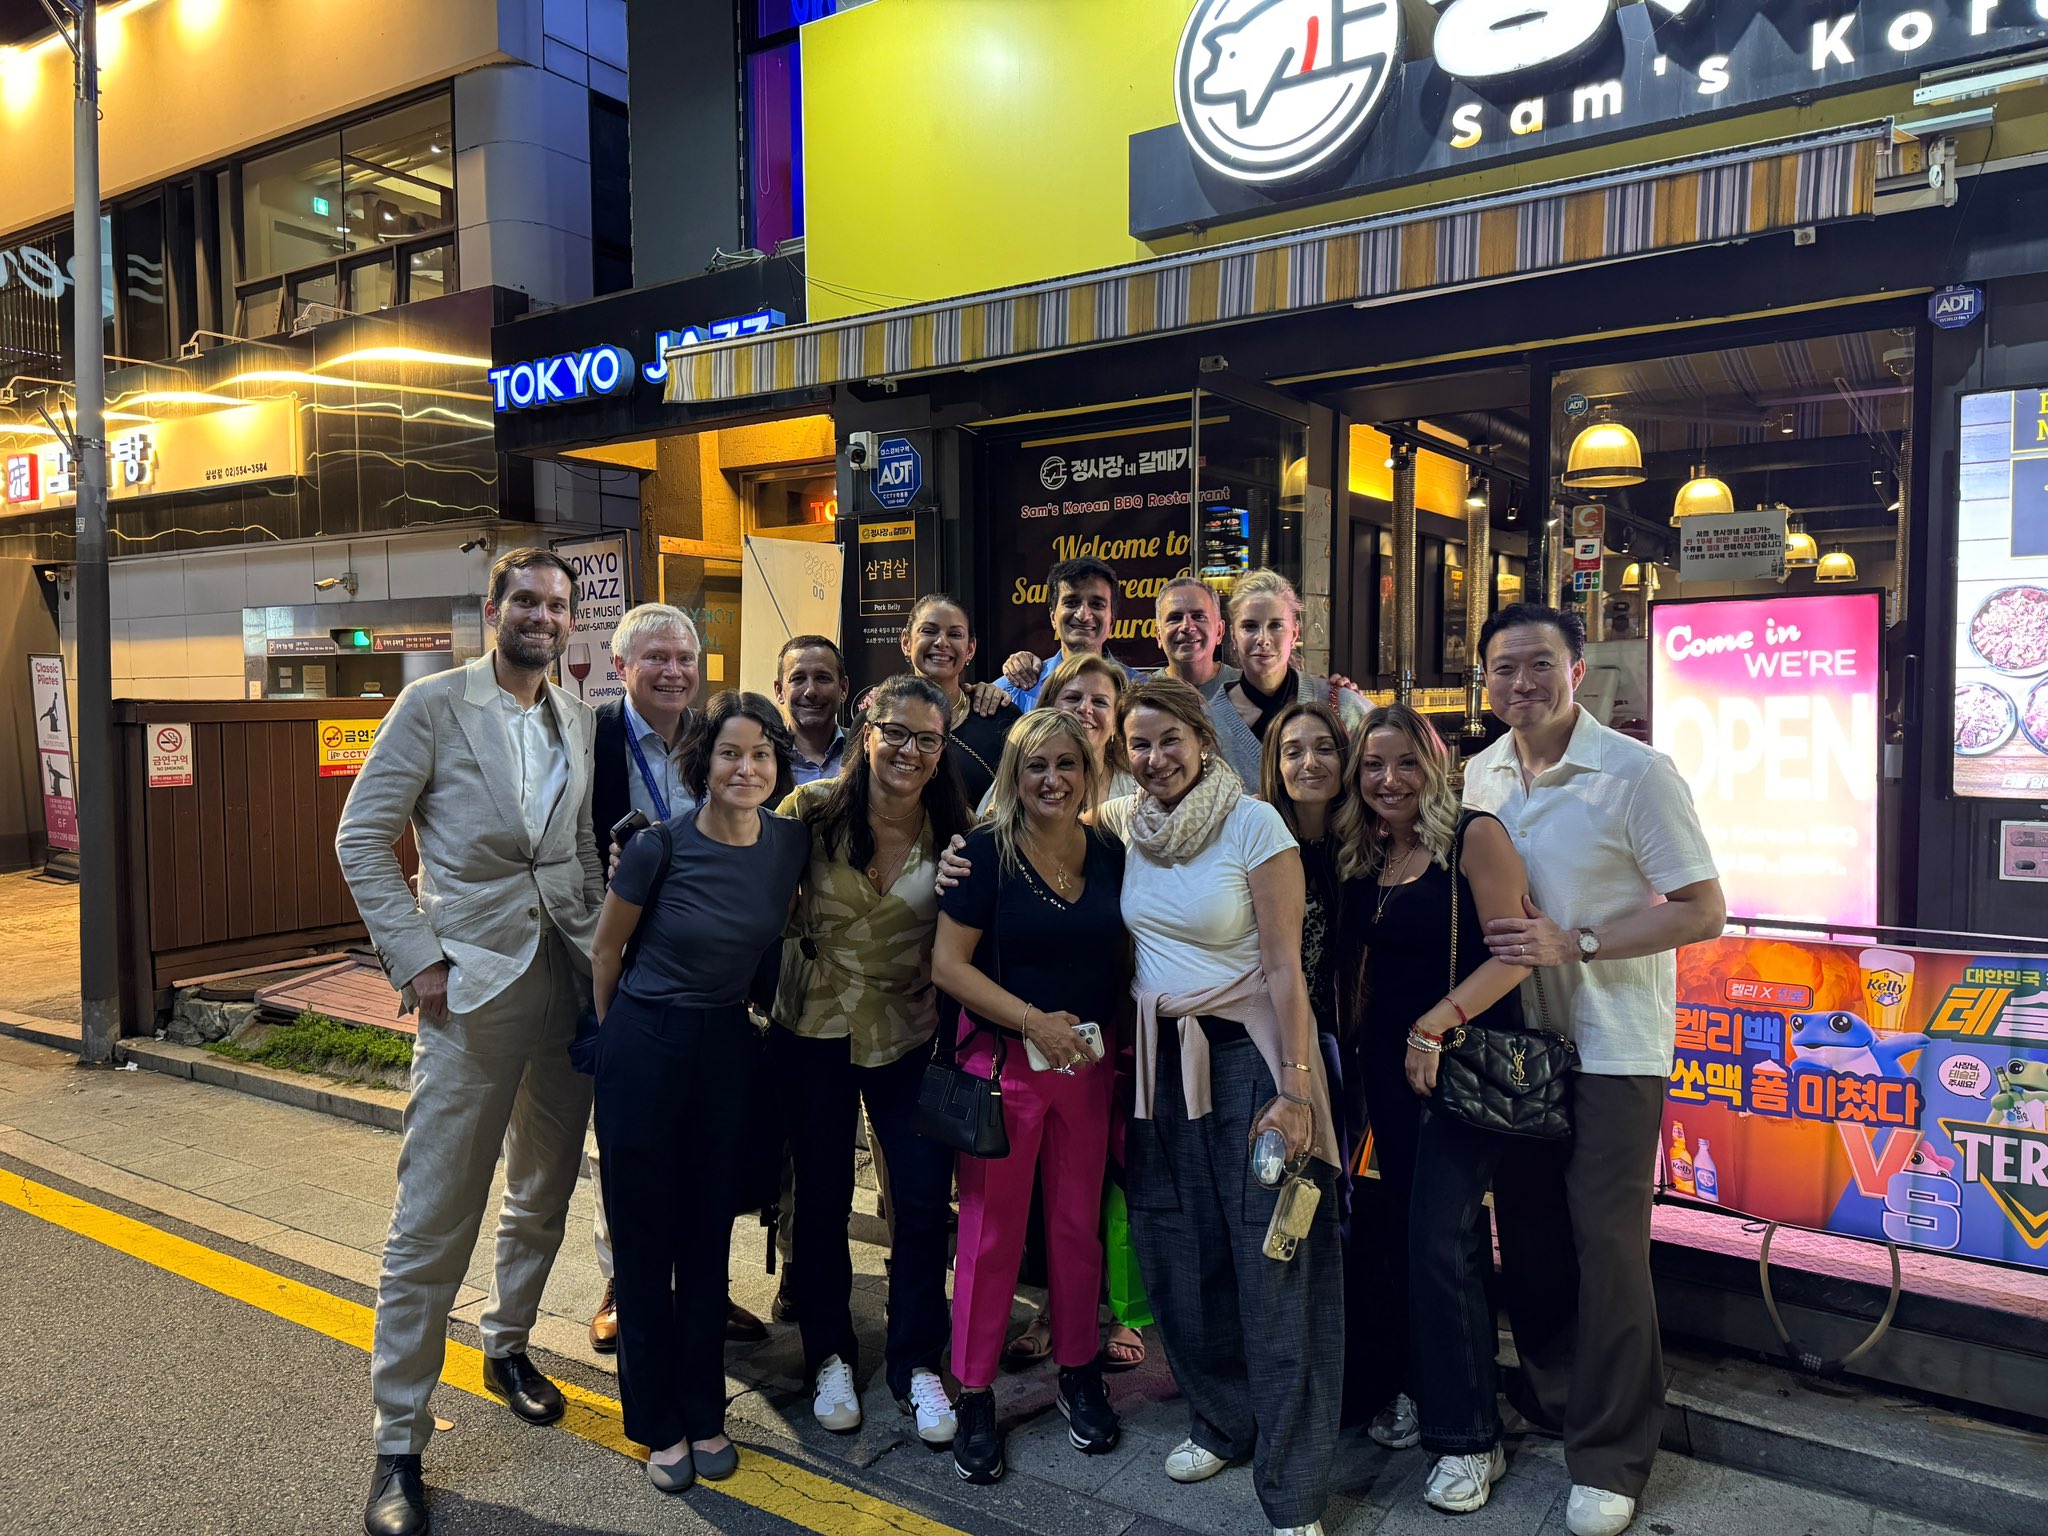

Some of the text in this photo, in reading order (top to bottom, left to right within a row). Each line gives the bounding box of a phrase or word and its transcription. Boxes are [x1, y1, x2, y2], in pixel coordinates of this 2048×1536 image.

[1450, 54, 1730, 149] Sam's
[1936, 294, 1973, 315] ADT
[489, 344, 623, 412] TOKYO
[1568, 401, 1584, 411] ADT
[45, 432, 152, 496] 감탕
[879, 460, 913, 487] ADT
[1021, 502, 1059, 519] Sam's
[1063, 500, 1110, 515] Korean
[1113, 495, 1143, 511] BBQ
[1052, 530, 1191, 563] Welcome to
[567, 552, 618, 576] OKYO
[865, 558, 908, 581] 삼겹살
[580, 578, 620, 601] JAZZ
[1118, 576, 1166, 600] rean
[1576, 576, 1600, 586] JCB
[593, 605, 621, 618] MUSIC
[874, 603, 901, 612] Pork Belly
[1665, 617, 1802, 662] Come in
[35, 661, 59, 674] Classic
[1743, 649, 1857, 679] WE'RE
[37, 674, 59, 686] Pilates
[589, 687, 626, 697] CHAMPAGN
[1667, 692, 1871, 802] OPEN
[152, 754, 189, 766] 금연구역
[1867, 979, 1907, 995] Kelly
[1966, 968, 2041, 986] 대한민국
[1731, 983, 1757, 998] 켈리
[1669, 1057, 1743, 1107] 쏘맥
[1798, 1073, 1920, 1126] 미쳤다
[1948, 1080, 1977, 1089] 주세요!
[1672, 1161, 1692, 1175] Kelly
